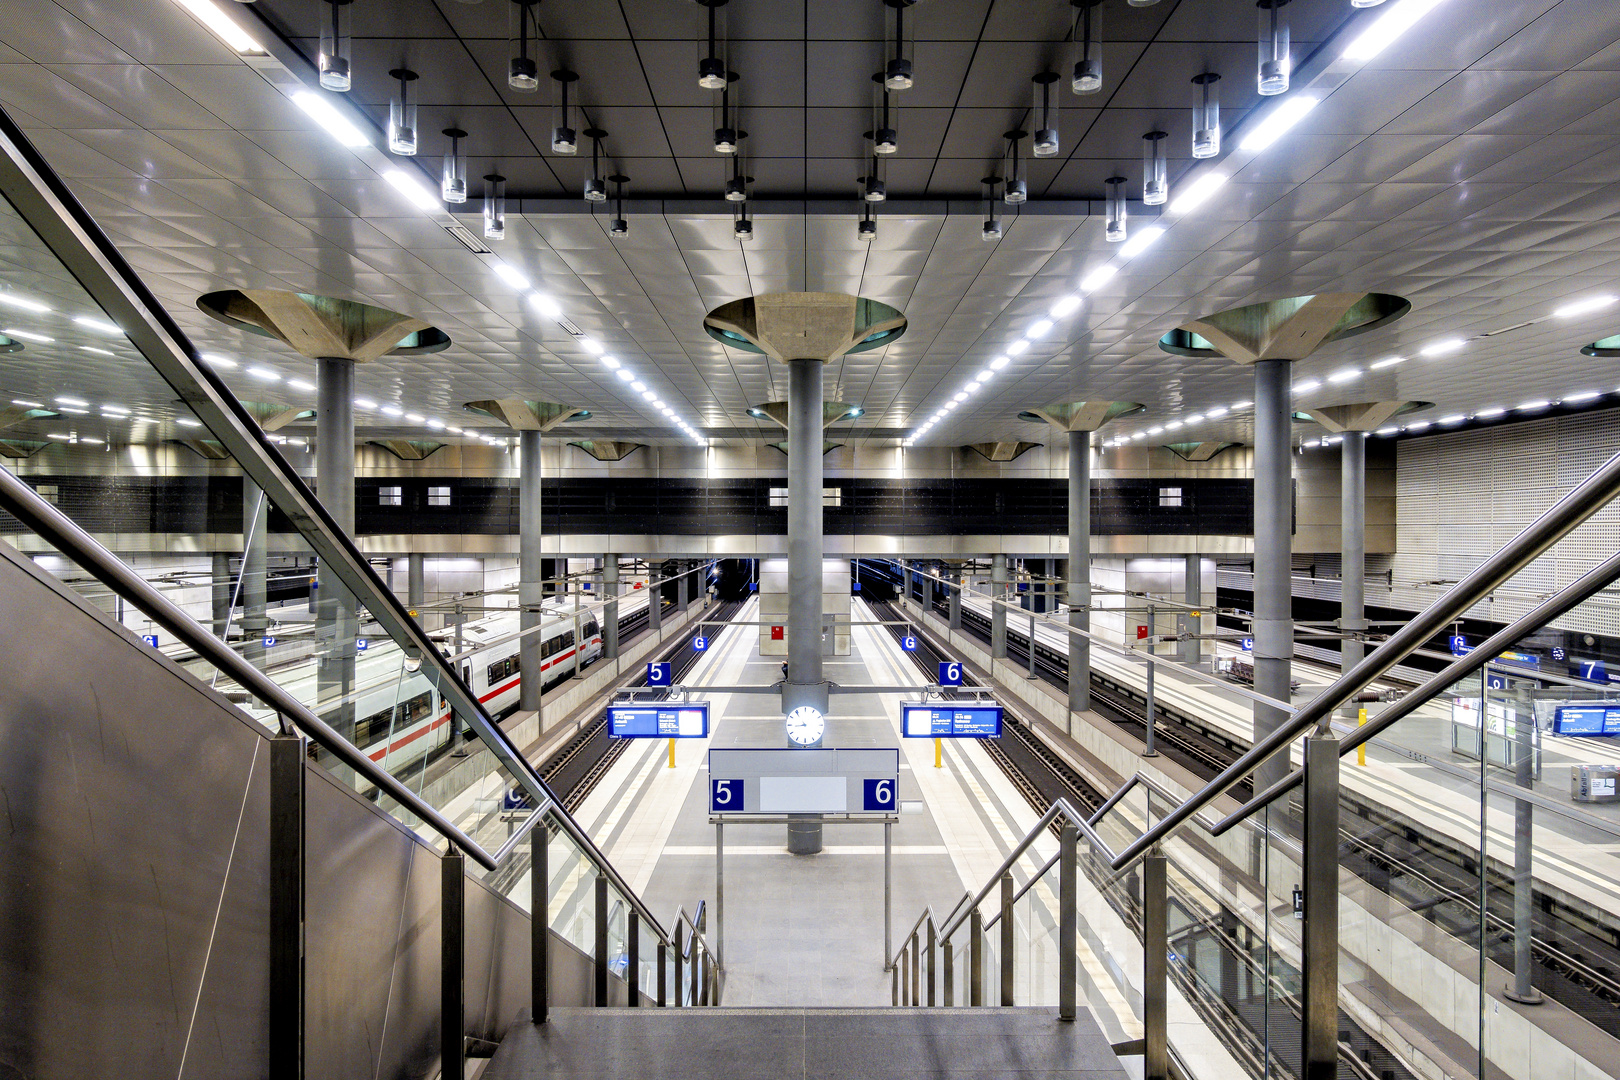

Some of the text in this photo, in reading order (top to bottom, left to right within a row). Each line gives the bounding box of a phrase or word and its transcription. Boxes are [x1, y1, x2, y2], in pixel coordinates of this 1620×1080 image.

[694, 637, 705, 649] G
[905, 637, 916, 649] G
[650, 663, 663, 681] 5
[947, 663, 960, 681] 6
[1583, 661, 1597, 680] 7
[717, 780, 731, 804] 5
[876, 780, 891, 804] 6
